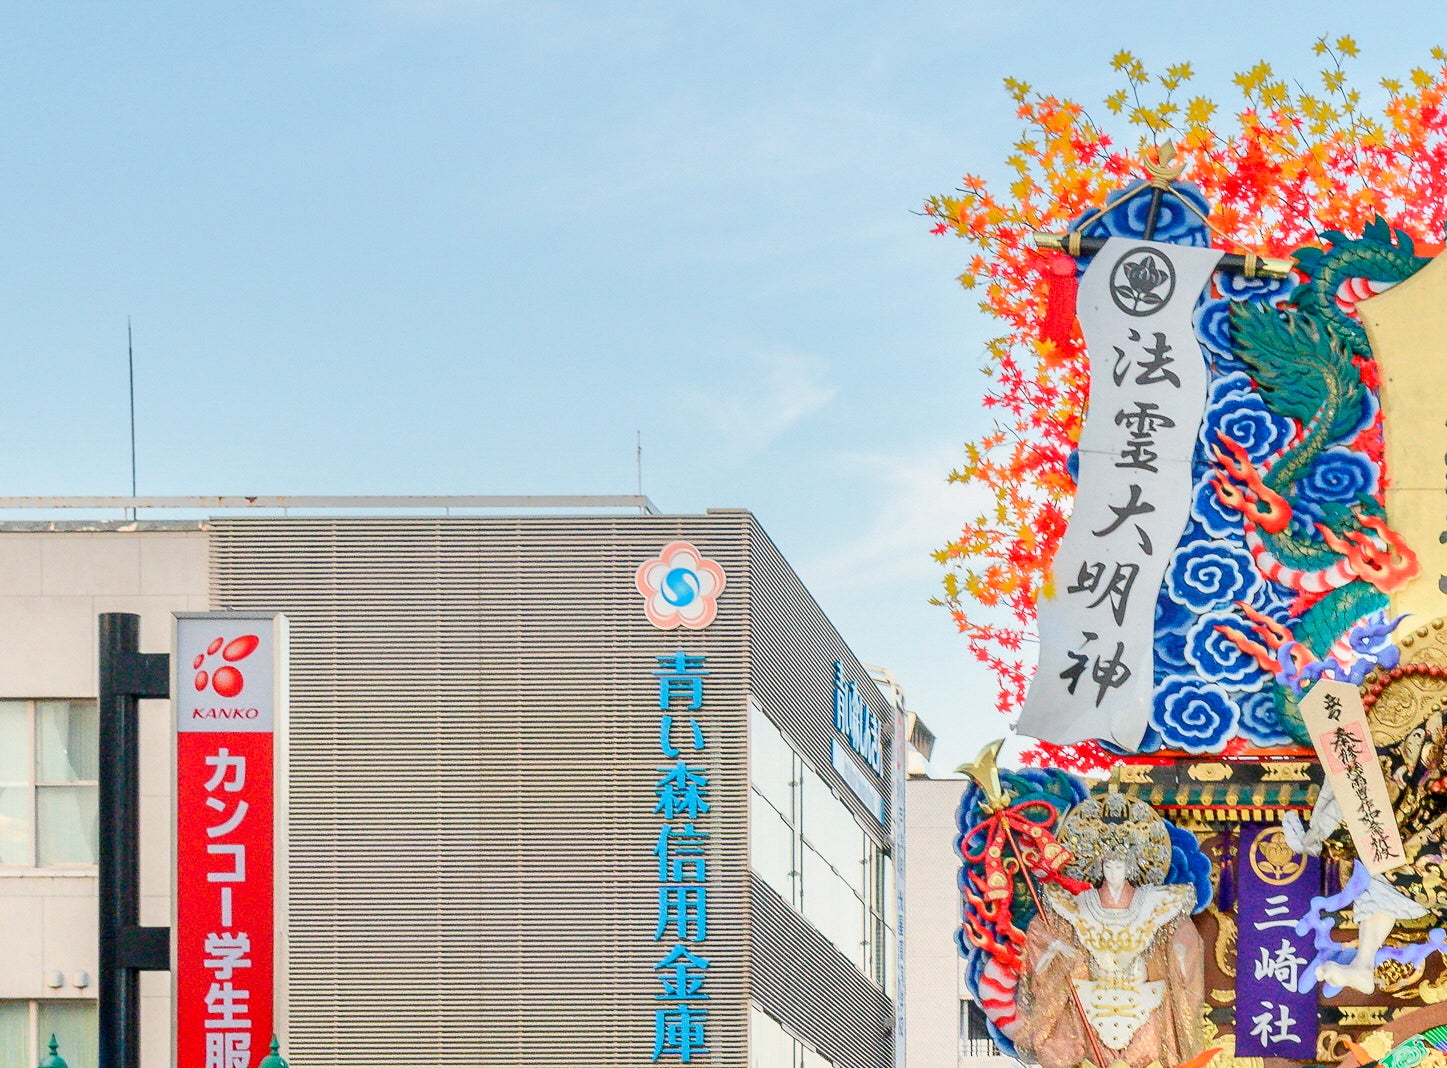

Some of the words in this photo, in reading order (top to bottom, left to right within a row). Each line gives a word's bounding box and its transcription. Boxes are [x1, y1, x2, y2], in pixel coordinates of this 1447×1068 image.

[192, 706, 260, 720] KANKO
[651, 650, 712, 1064] 青い森信用金庫
[1249, 894, 1307, 1048] 三崎社
